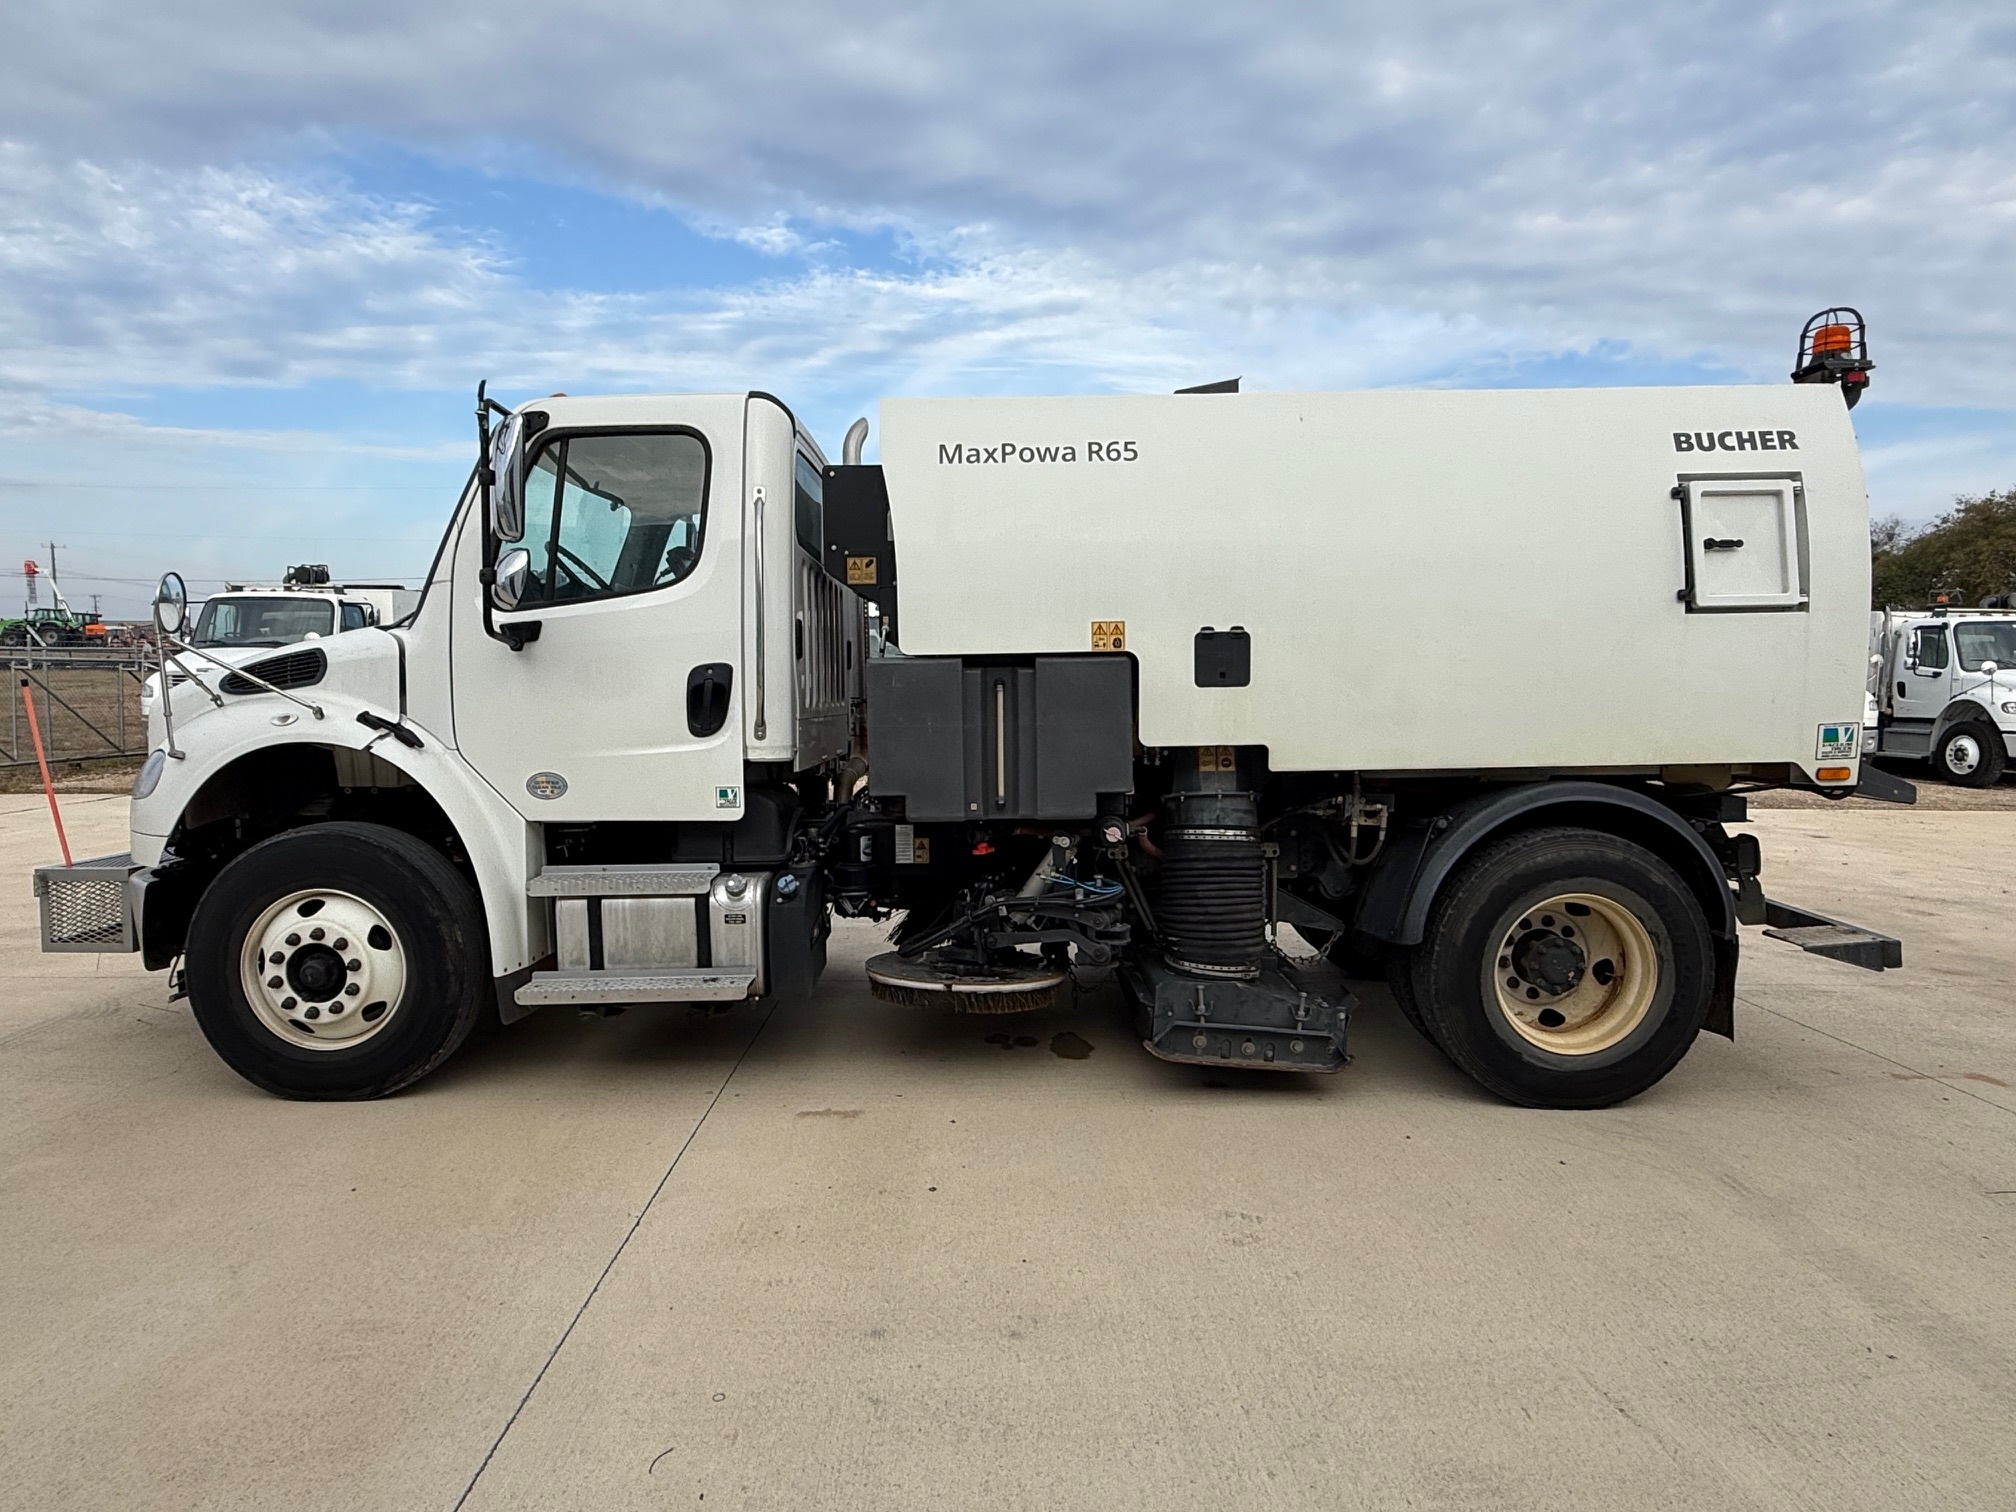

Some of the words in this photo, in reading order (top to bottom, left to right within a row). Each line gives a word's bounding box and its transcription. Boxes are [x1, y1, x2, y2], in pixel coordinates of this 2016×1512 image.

[1672, 430, 1800, 452] BUCHER
[938, 443, 1077, 464] MaxPowa
[1087, 441, 1139, 462] R65
